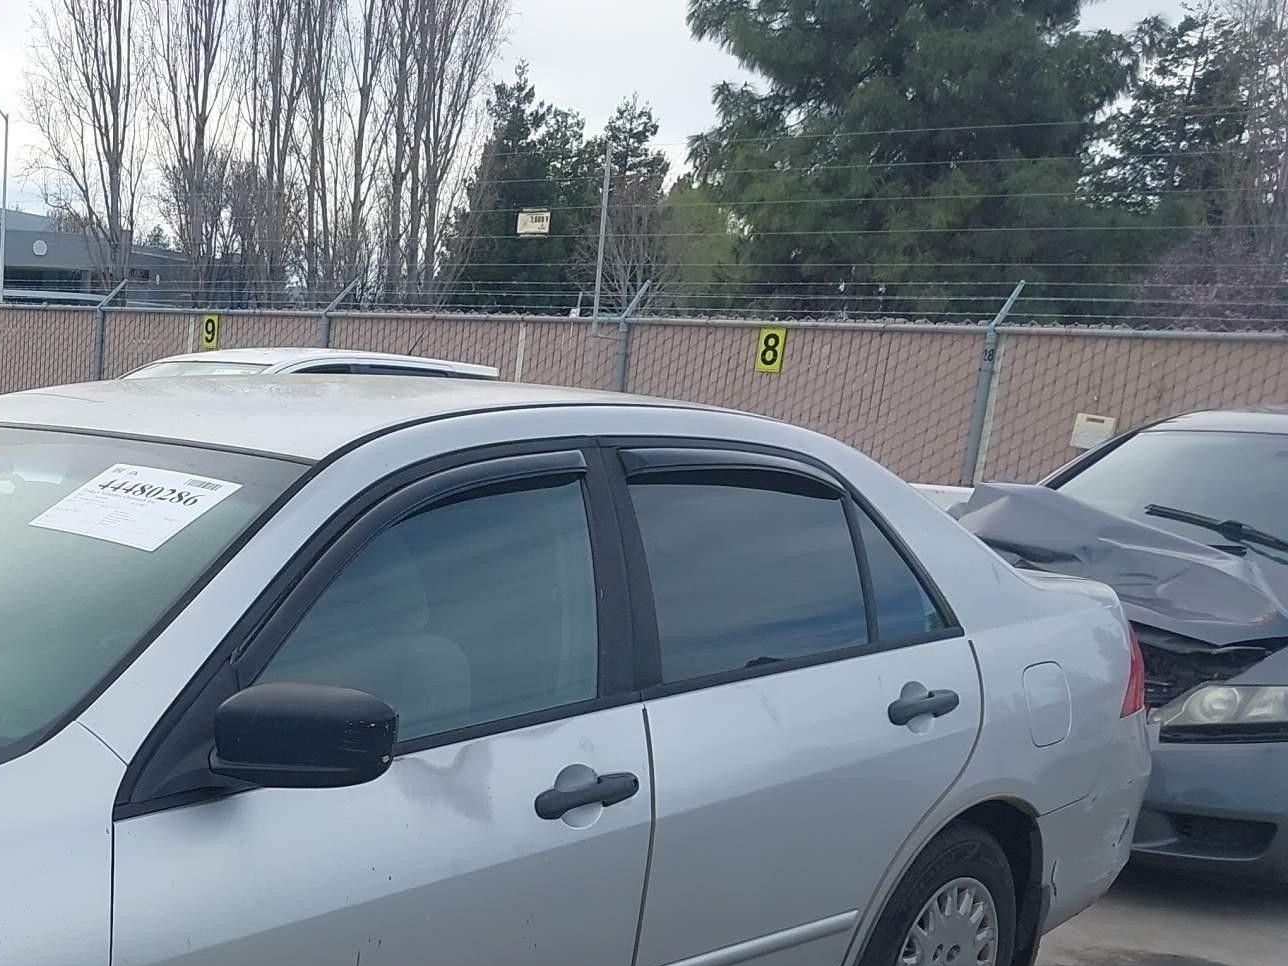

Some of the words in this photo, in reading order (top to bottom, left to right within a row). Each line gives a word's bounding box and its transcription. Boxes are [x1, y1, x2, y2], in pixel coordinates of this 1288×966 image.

[204, 318, 216, 344] 9
[760, 332, 780, 366] 8
[98, 479, 206, 506] 44480286
